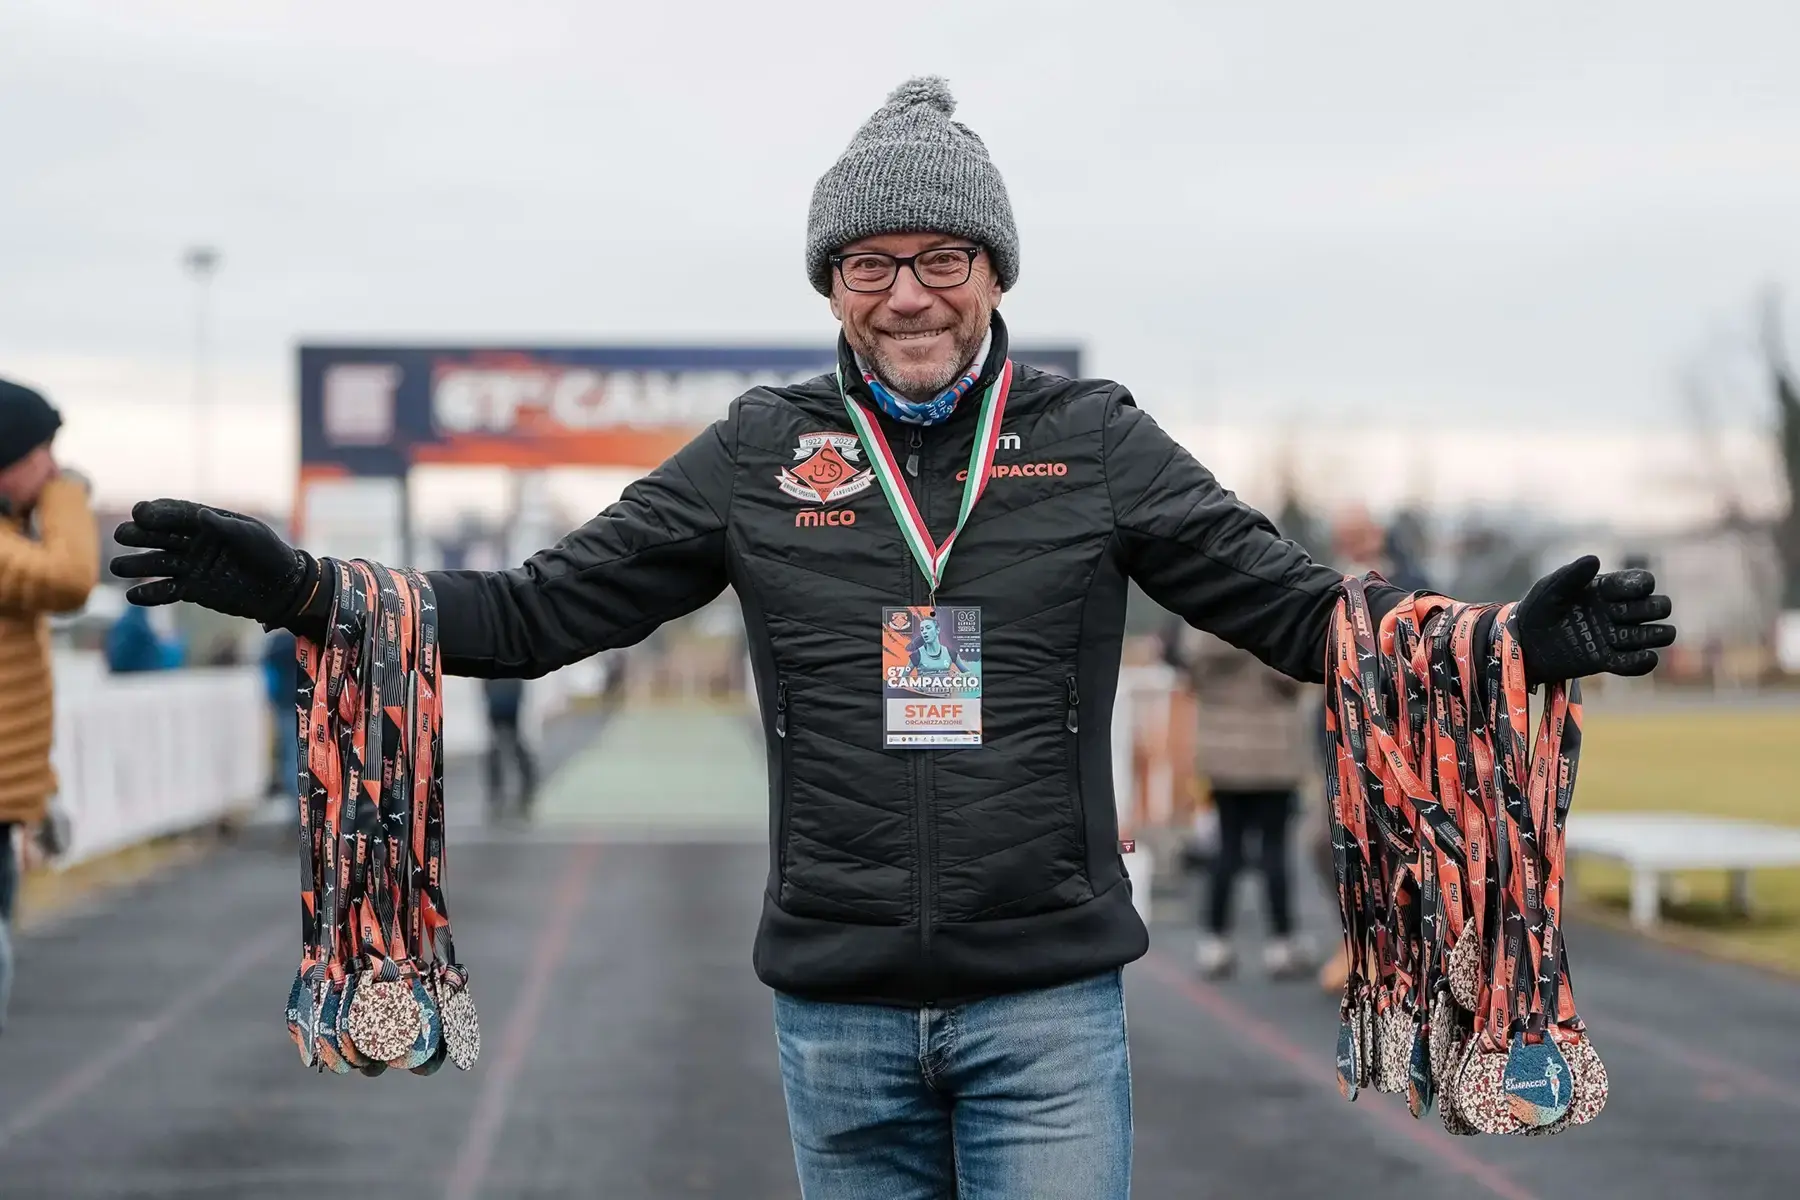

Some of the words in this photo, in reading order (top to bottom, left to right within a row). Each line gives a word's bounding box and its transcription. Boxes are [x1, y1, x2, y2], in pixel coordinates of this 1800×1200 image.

[805, 438, 822, 446] 1922
[834, 437, 853, 445] 2022
[955, 462, 1068, 482] CPACCIO
[887, 677, 979, 688] CAMPACCIO
[904, 705, 963, 718] STAFF
